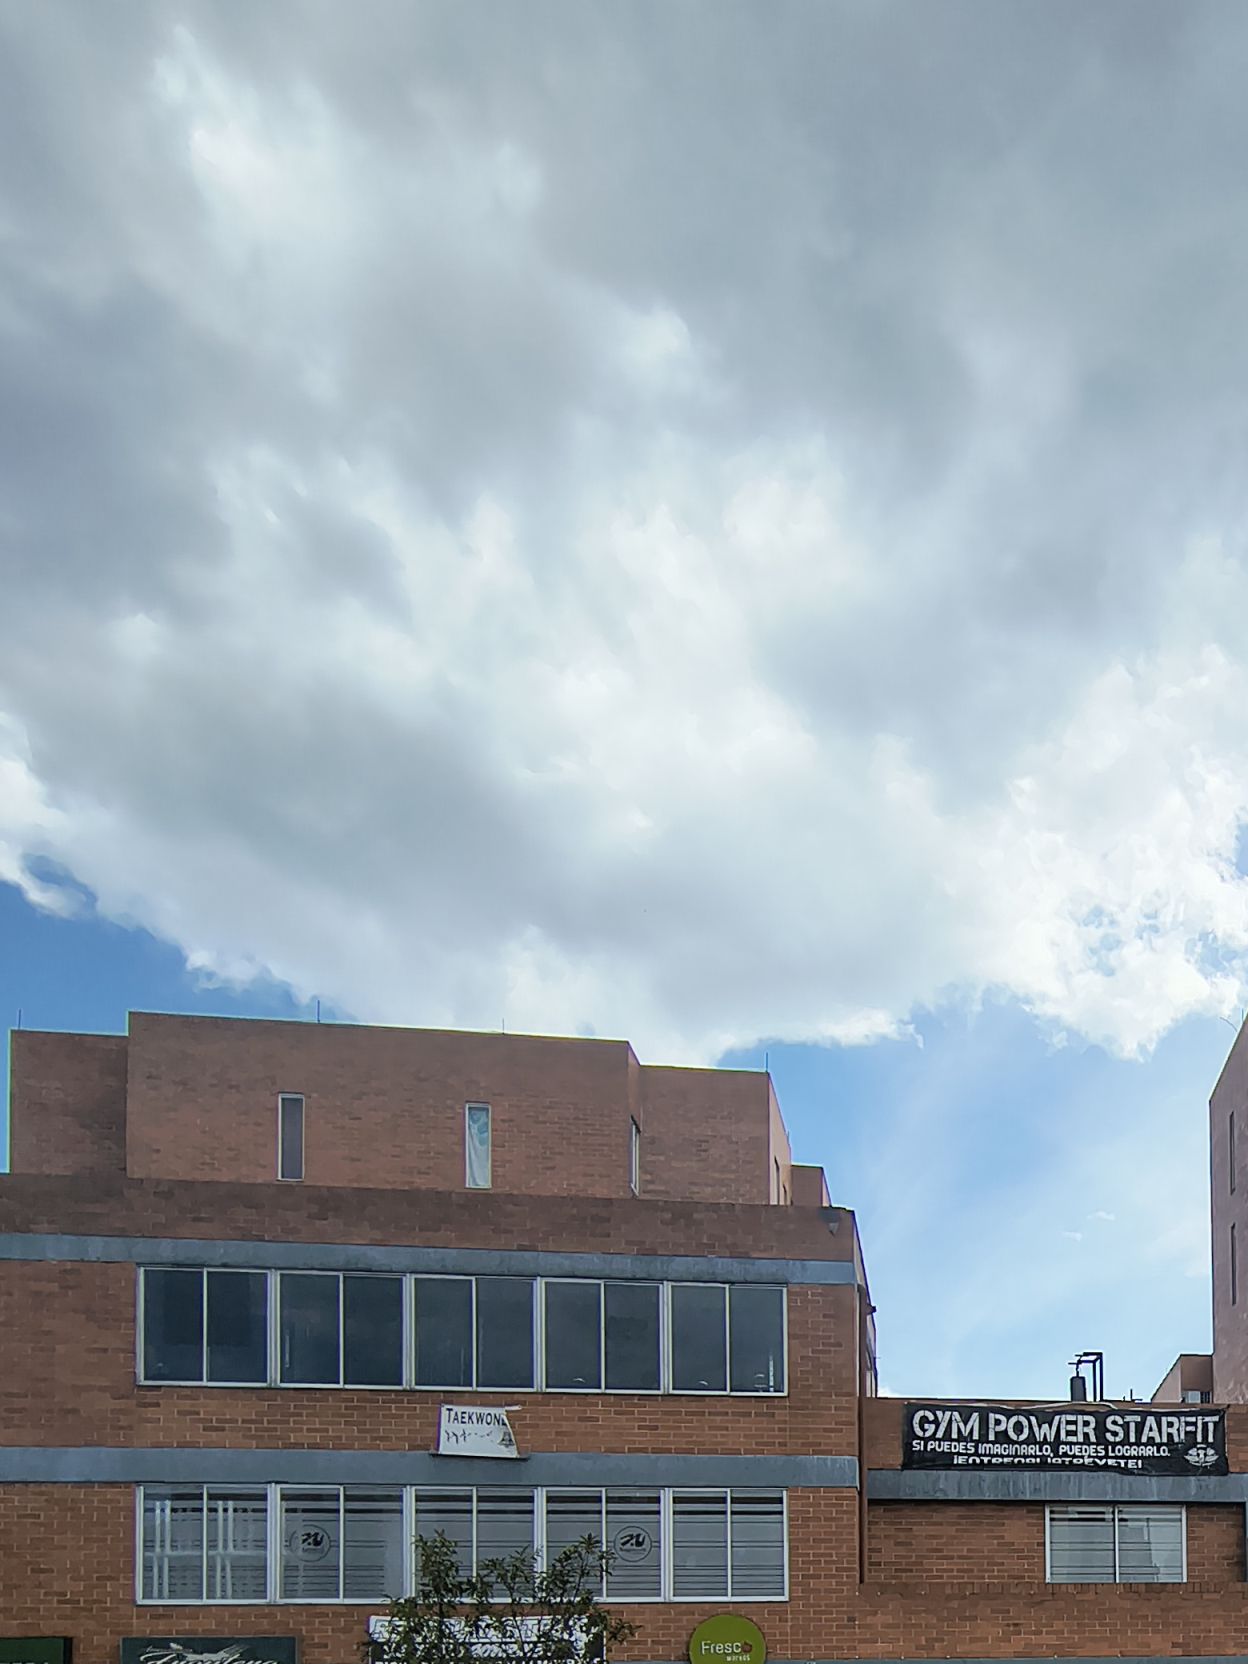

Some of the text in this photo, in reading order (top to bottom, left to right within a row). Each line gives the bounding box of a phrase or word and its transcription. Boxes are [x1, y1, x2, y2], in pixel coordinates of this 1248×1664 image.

[912, 1410, 1220, 1444] GYM POWER STARFIT
[912, 1440, 925, 1451] SI
[927, 1441, 975, 1454] PUEDES
[1058, 1444, 1106, 1457] PUEDES
[1107, 1445, 1171, 1457] LOGRARLO.
